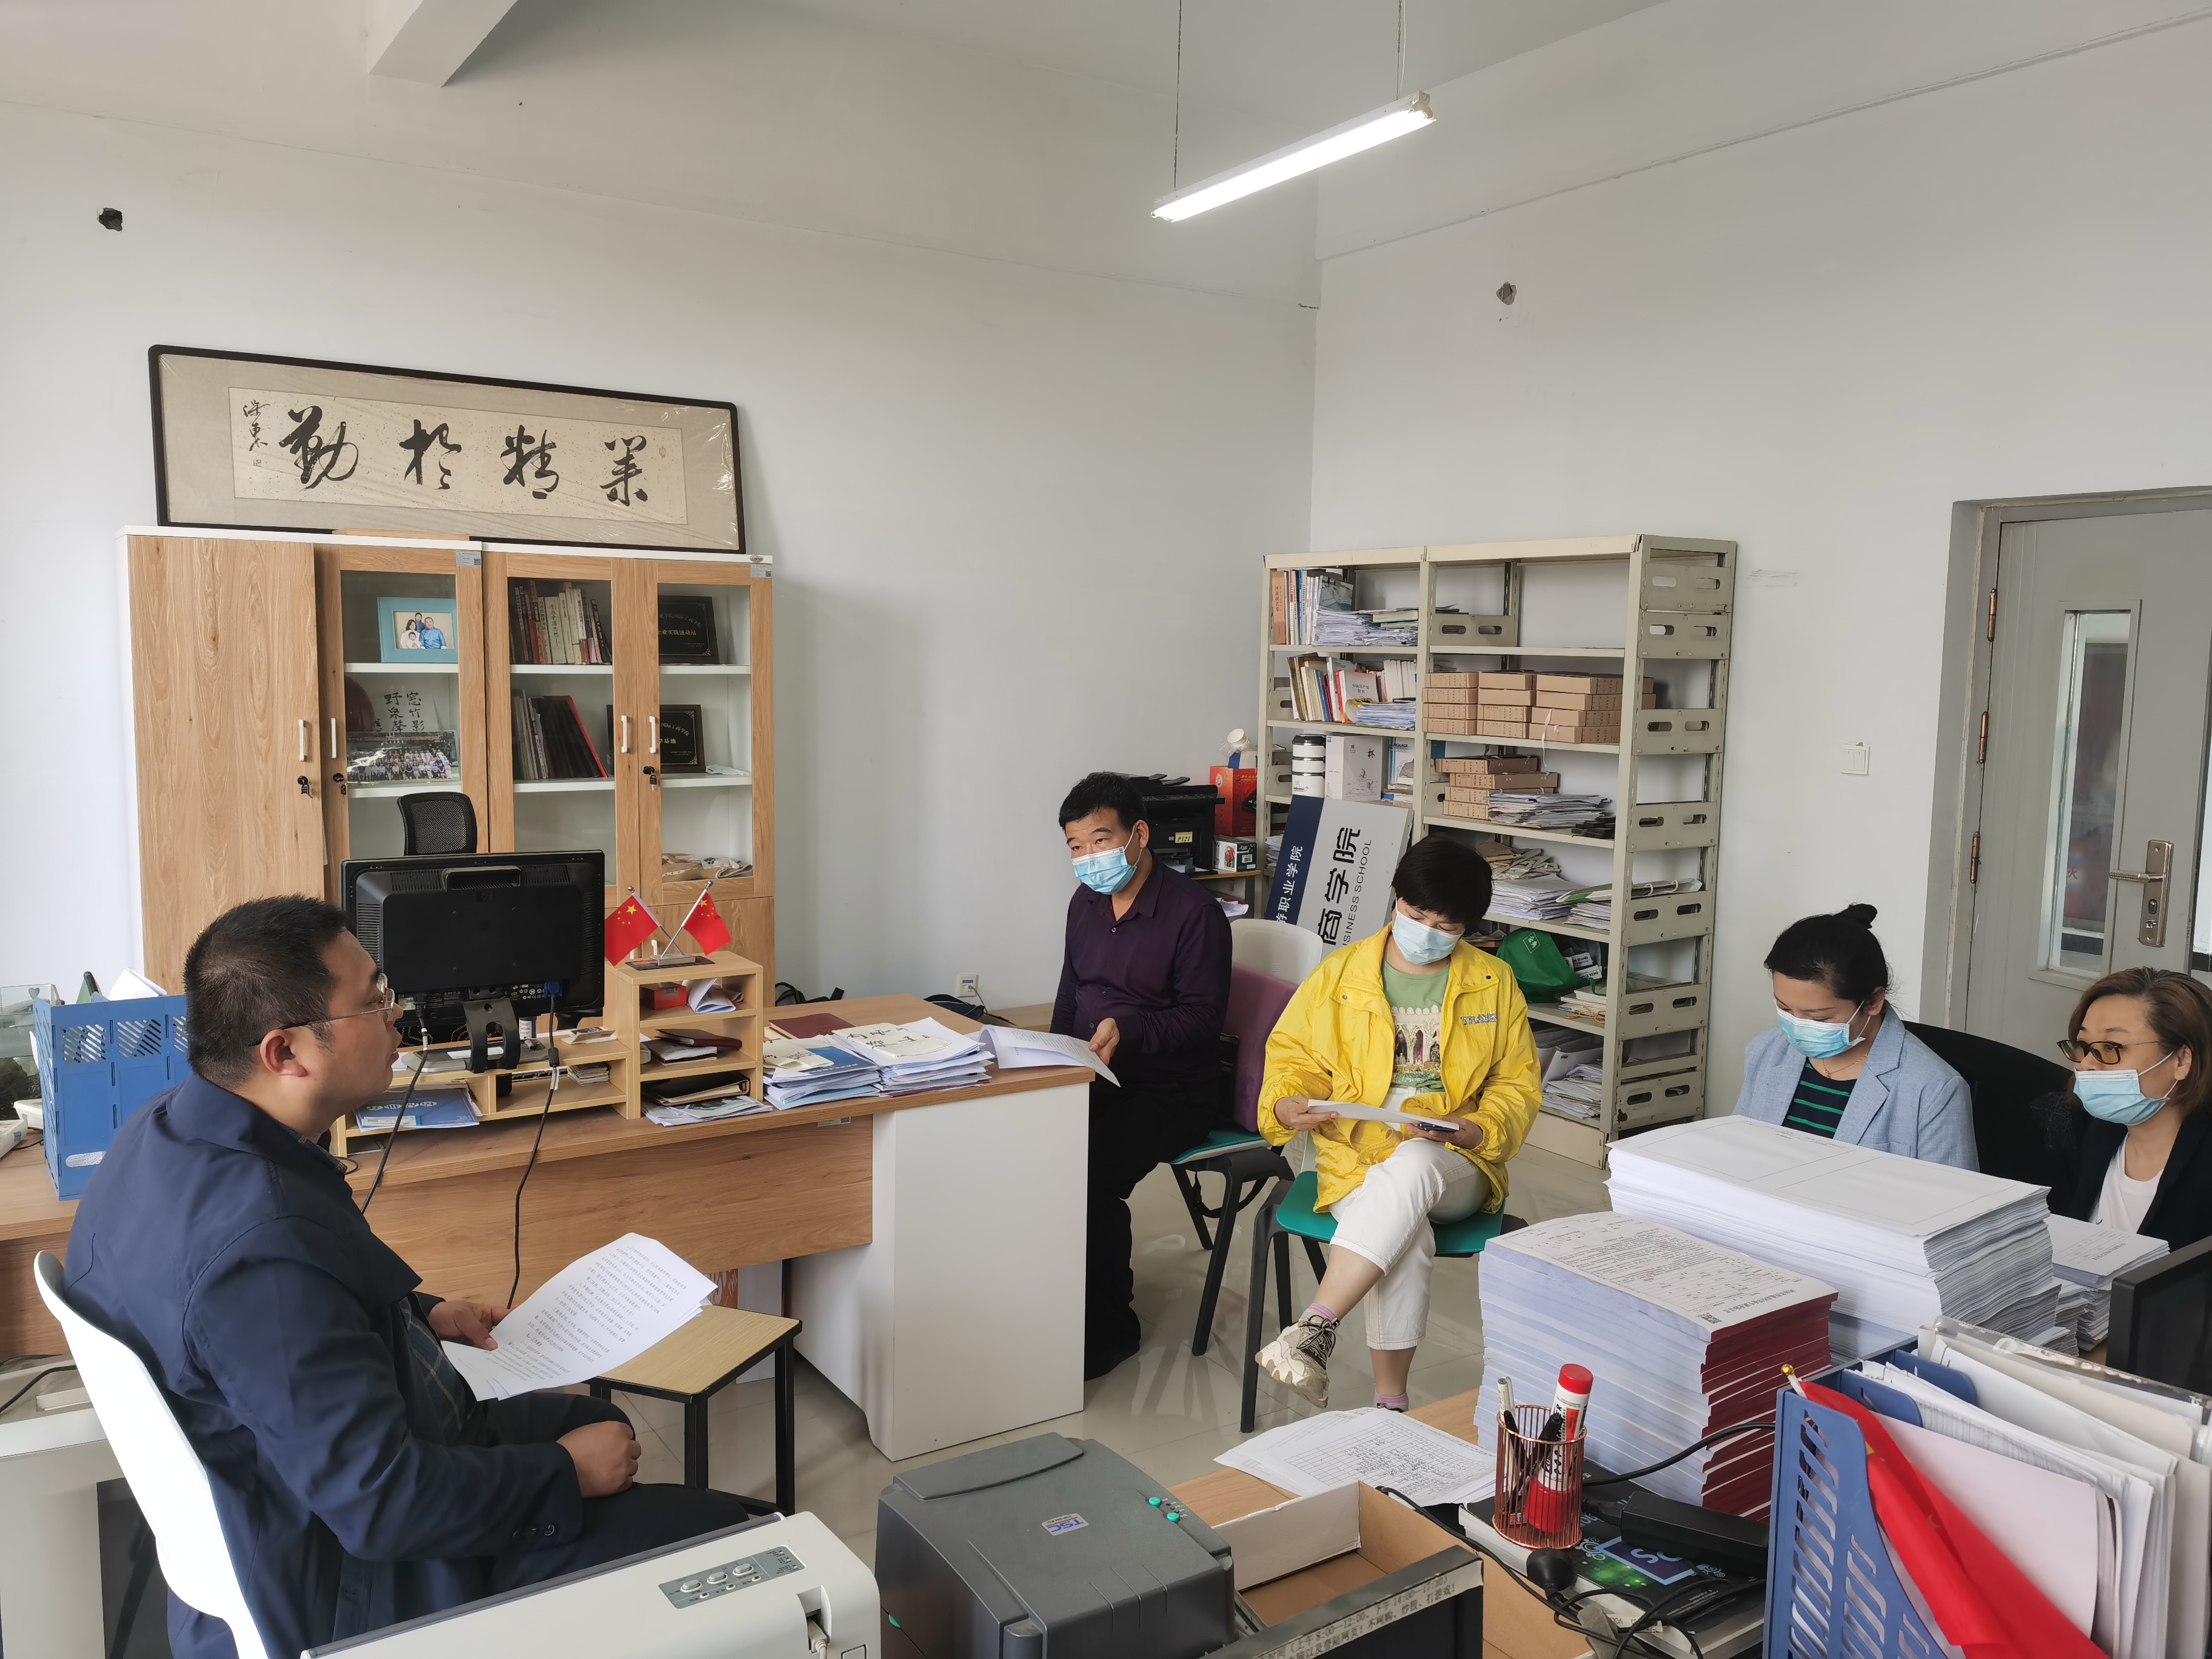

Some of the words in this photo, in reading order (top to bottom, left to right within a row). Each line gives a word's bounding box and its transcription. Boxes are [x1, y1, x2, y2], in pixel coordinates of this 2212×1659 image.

[1318, 827, 1361, 945] 商学院
[1354, 840, 1372, 893] SCHOOL
[1047, 1519, 1084, 1532] TSC
